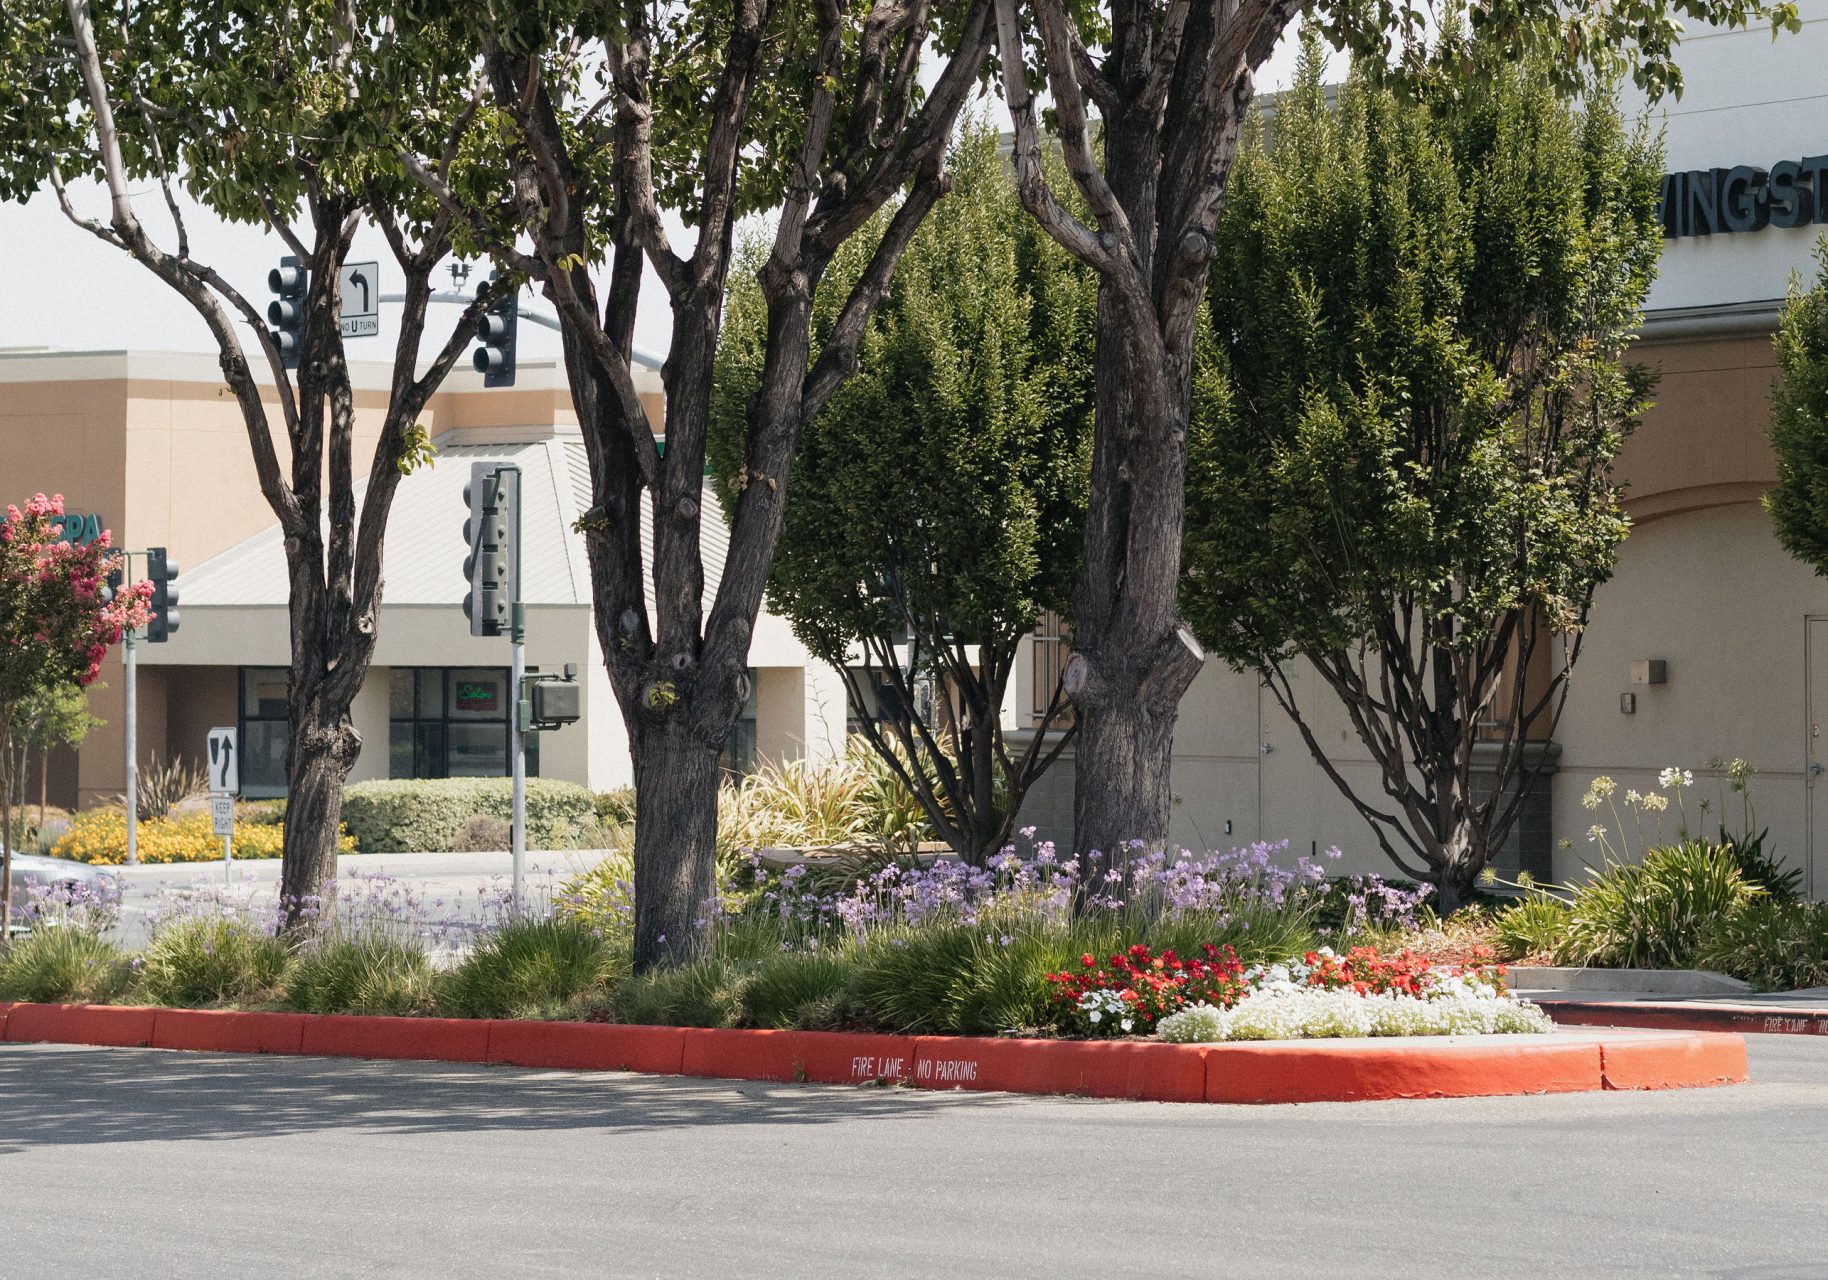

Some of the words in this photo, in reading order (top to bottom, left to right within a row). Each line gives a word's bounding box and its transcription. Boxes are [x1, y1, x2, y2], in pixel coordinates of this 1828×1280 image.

[340, 323, 350, 331] NO
[352, 320, 357, 332] U
[360, 321, 376, 330] TURN
[50, 514, 99, 548] SPA
[215, 802, 230, 814] KEEP
[214, 817, 231, 829] RIGHT
[1764, 1016, 1783, 1032] FIRE
[851, 1057, 874, 1077] FIRE
[877, 1058, 903, 1078] LANE
[917, 1059, 931, 1079] NO
[935, 1061, 977, 1081] PARKING
